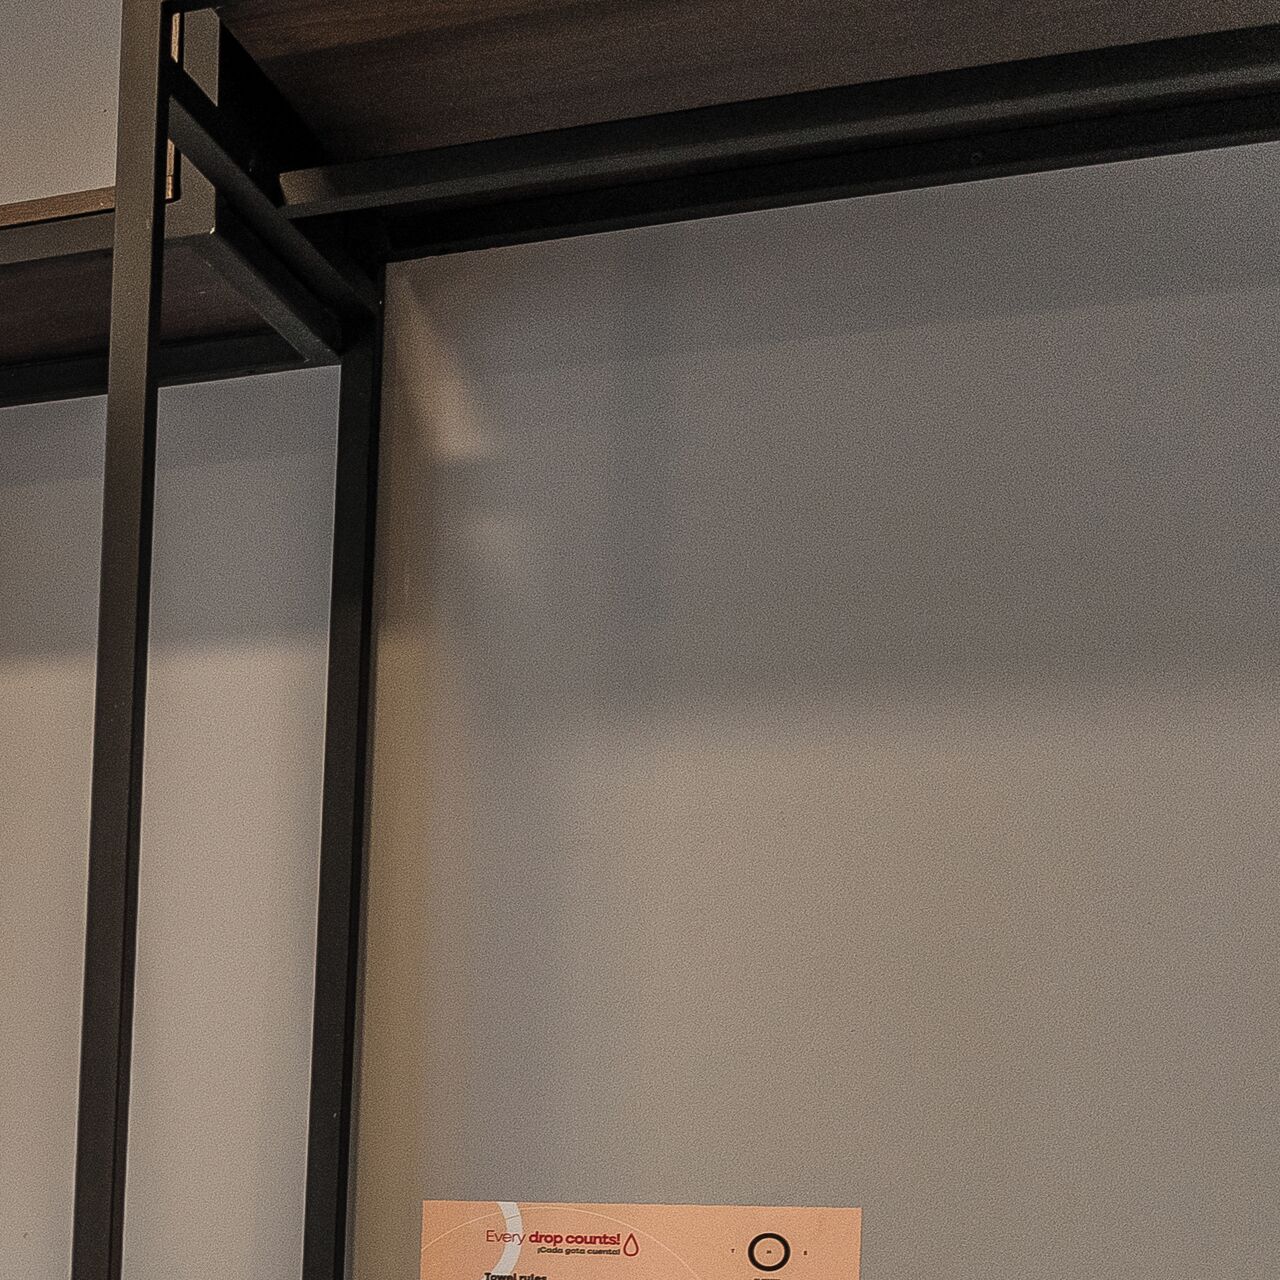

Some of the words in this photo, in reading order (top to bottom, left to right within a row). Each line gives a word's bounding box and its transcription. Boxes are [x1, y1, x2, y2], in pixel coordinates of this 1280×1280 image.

[486, 1230, 526, 1245] Every
[529, 1231, 562, 1246] drop
[565, 1233, 621, 1245] counts!
